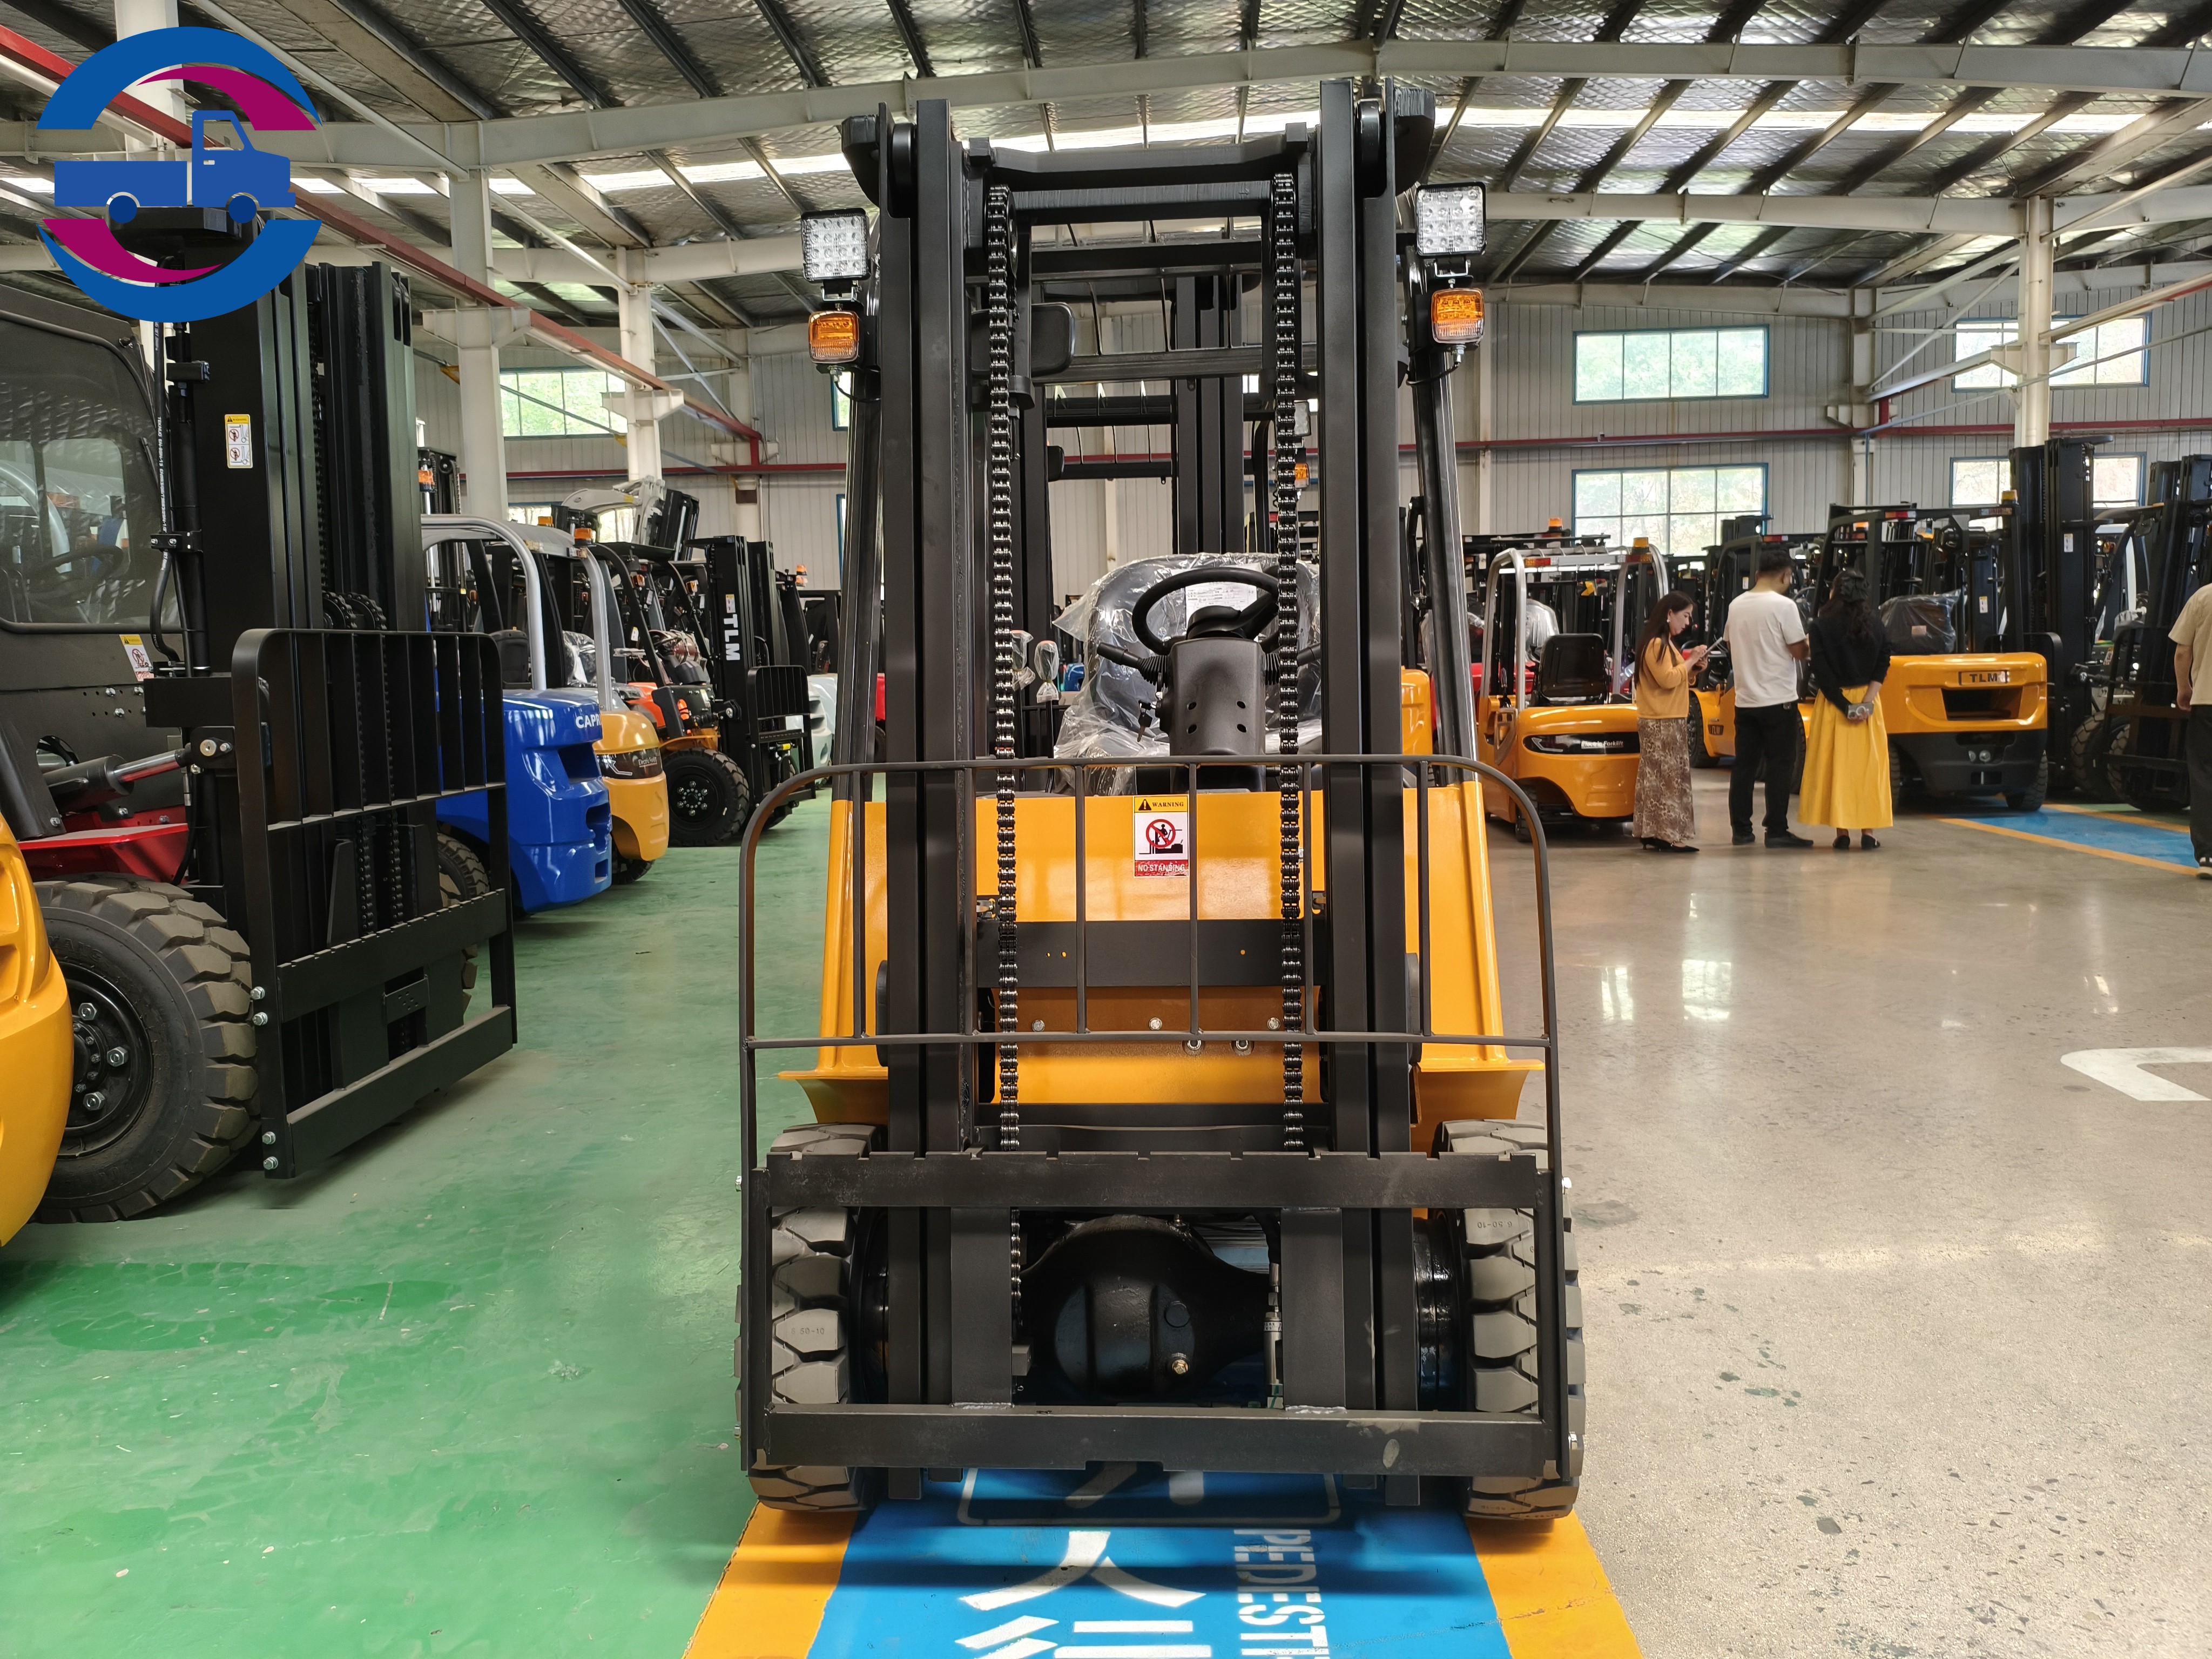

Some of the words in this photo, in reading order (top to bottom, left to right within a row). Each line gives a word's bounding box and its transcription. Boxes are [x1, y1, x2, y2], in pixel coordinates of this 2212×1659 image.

[724, 613, 740, 660] TLM
[1969, 673, 1998, 683] TLM
[1138, 864, 1148, 872] NO
